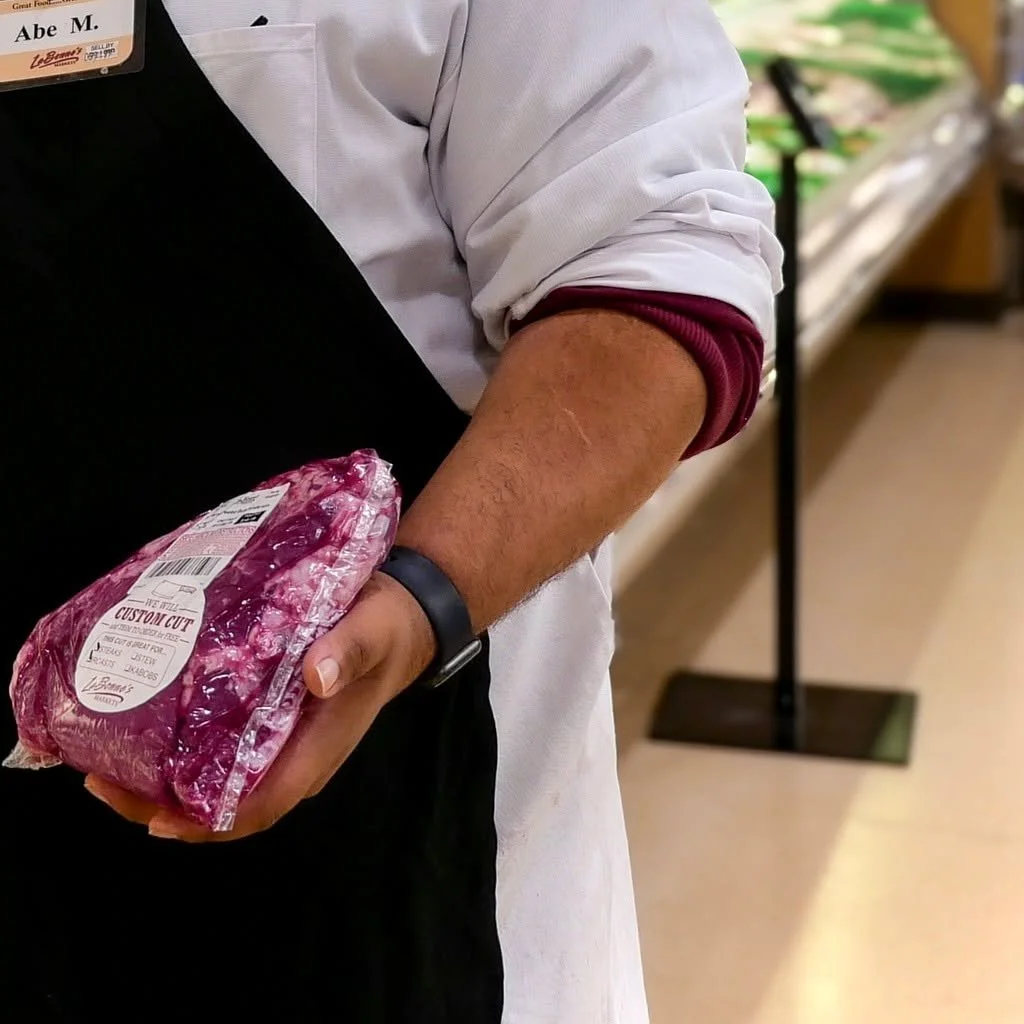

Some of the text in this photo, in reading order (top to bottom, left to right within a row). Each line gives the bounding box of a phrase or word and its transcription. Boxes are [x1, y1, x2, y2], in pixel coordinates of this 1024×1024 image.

[12, 1, 32, 11] Great
[14, 14, 99, 43] Abe M.
[114, 606, 195, 633] CUSTOM CUT
